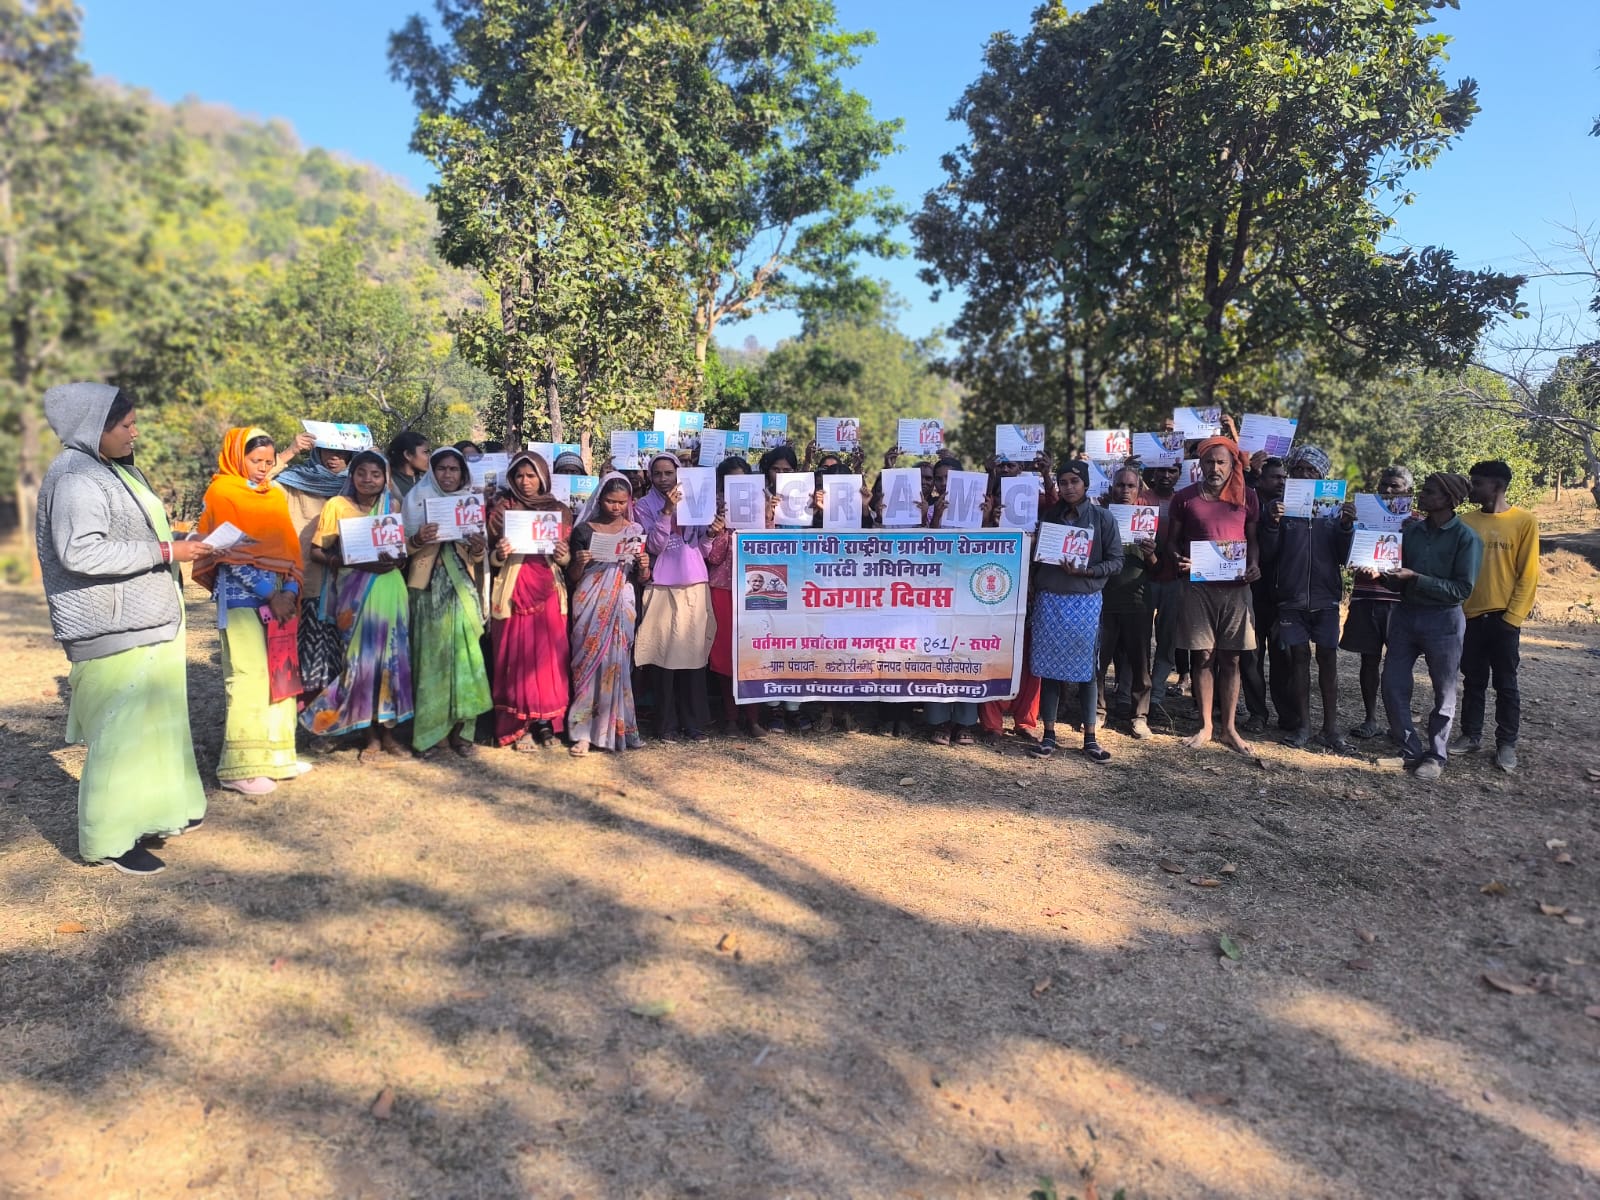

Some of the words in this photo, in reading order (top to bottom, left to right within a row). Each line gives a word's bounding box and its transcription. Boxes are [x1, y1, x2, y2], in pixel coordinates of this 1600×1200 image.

[767, 415, 782, 425] 125
[643, 433, 659, 442] 125
[839, 427, 857, 441] 125
[920, 430, 940, 444] 125
[1107, 438, 1127, 454] 125
[576, 478, 592, 487] 125
[1322, 482, 1338, 491] 125
[681, 477, 713, 519] V
[729, 482, 759, 523] B
[829, 482, 857, 521] R
[885, 474, 914, 520] A
[946, 477, 982, 522] M
[1004, 484, 1035, 526] G
[457, 506, 482, 526] 125
[1133, 515, 1156, 531] 125
[373, 527, 401, 547] 125
[534, 523, 559, 541] 125
[619, 541, 642, 556] 125
[742, 540, 798, 555] महात्मा
[802, 535, 840, 555] गांधी
[844, 535, 893, 557] राष्ट्रीय
[897, 536, 954, 555] ग्रामीण
[958, 535, 1017, 554] रोजगार
[1065, 537, 1089, 555] 125
[1377, 543, 1399, 560] 125
[815, 559, 858, 577] गारंटी
[862, 559, 942, 577] अधिनियम
[801, 581, 885, 608] रोजगार
[890, 581, 954, 608] दिवस
[752, 632, 797, 650] वर्तमान
[899, 637, 917, 651] दर
[769, 661, 785, 673] ग्राम
[876, 660, 902, 673] जनपद
[763, 682, 802, 694] जिला
[907, 681, 988, 696] (छत्तीसगढ़)
